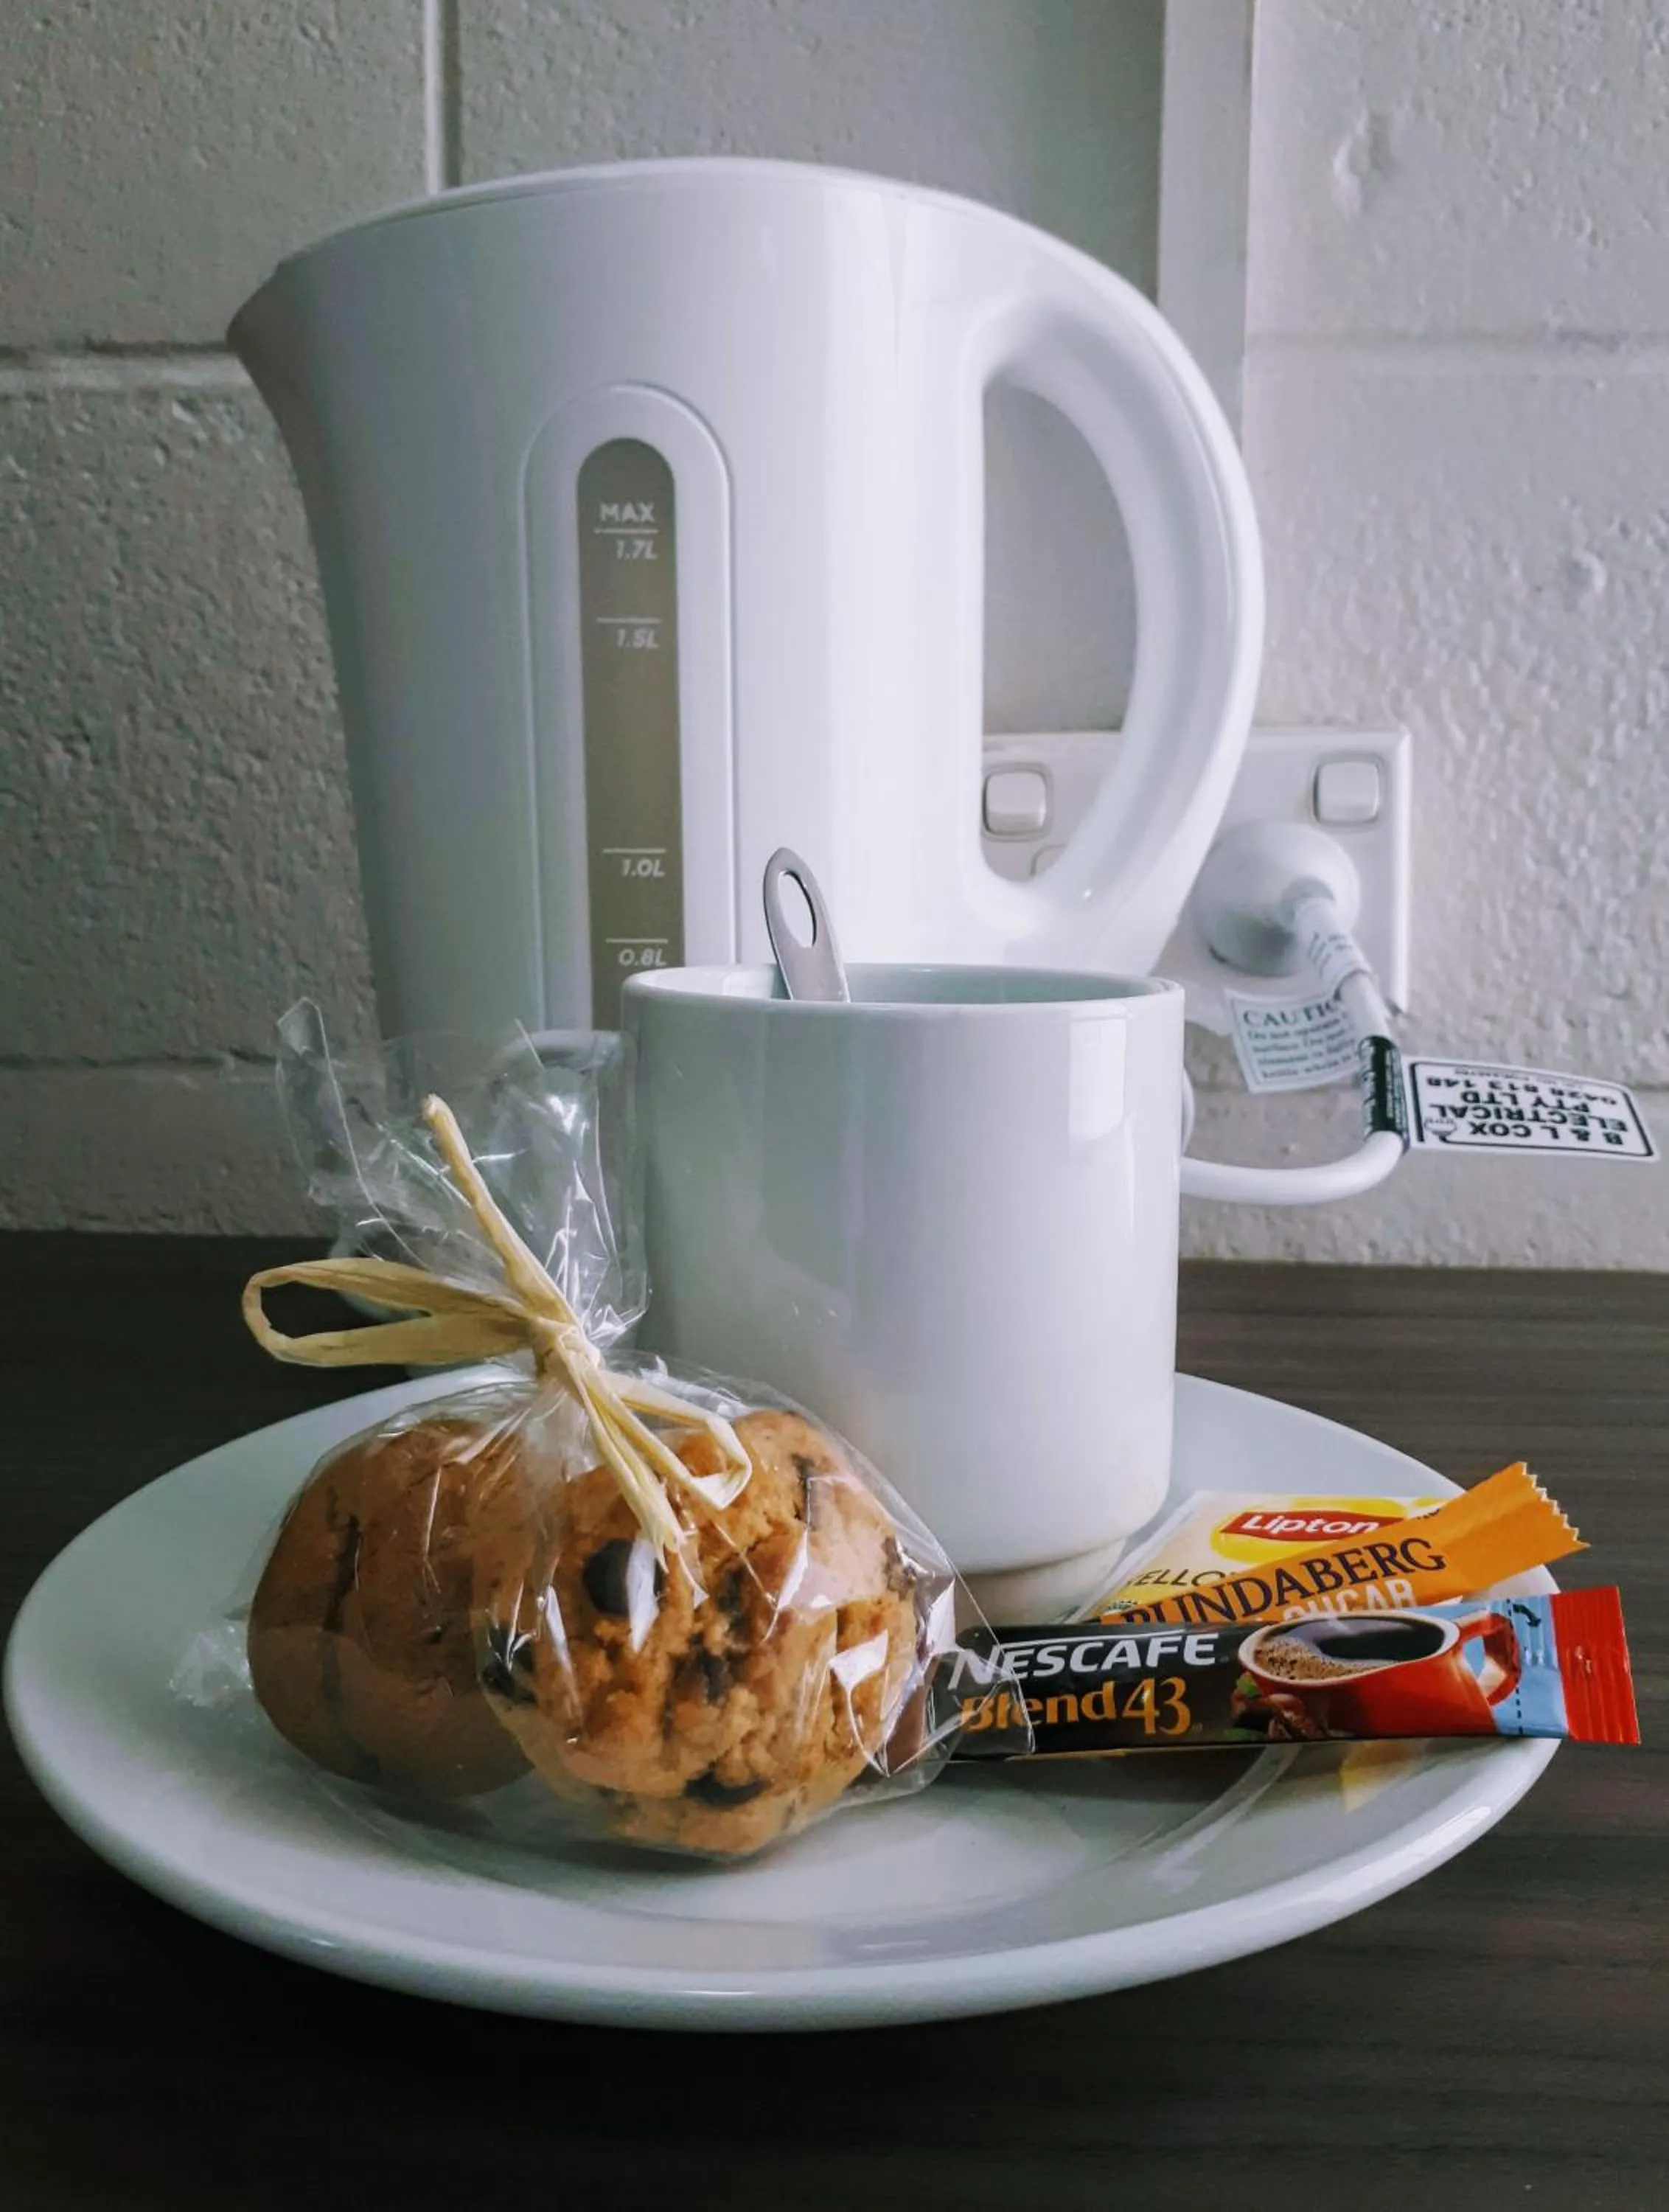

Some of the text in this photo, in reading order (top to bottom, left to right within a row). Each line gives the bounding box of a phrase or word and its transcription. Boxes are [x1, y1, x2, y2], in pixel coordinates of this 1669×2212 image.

[600, 501, 655, 522] MAX
[616, 539, 658, 560] 1.7L
[617, 628, 659, 650] 1.5L
[621, 858, 666, 877] 1.0L
[619, 947, 666, 967] 0.8L
[1461, 1091, 1590, 1114] PTY LTD
[1429, 1104, 1628, 1133] ELECTRICAL
[1469, 1121, 1624, 1146] B & L COX
[1241, 1514, 1380, 1534] Lipton
[1126, 1568, 1236, 1587] ELLO
[960, 1676, 1192, 1736] Blend 43
